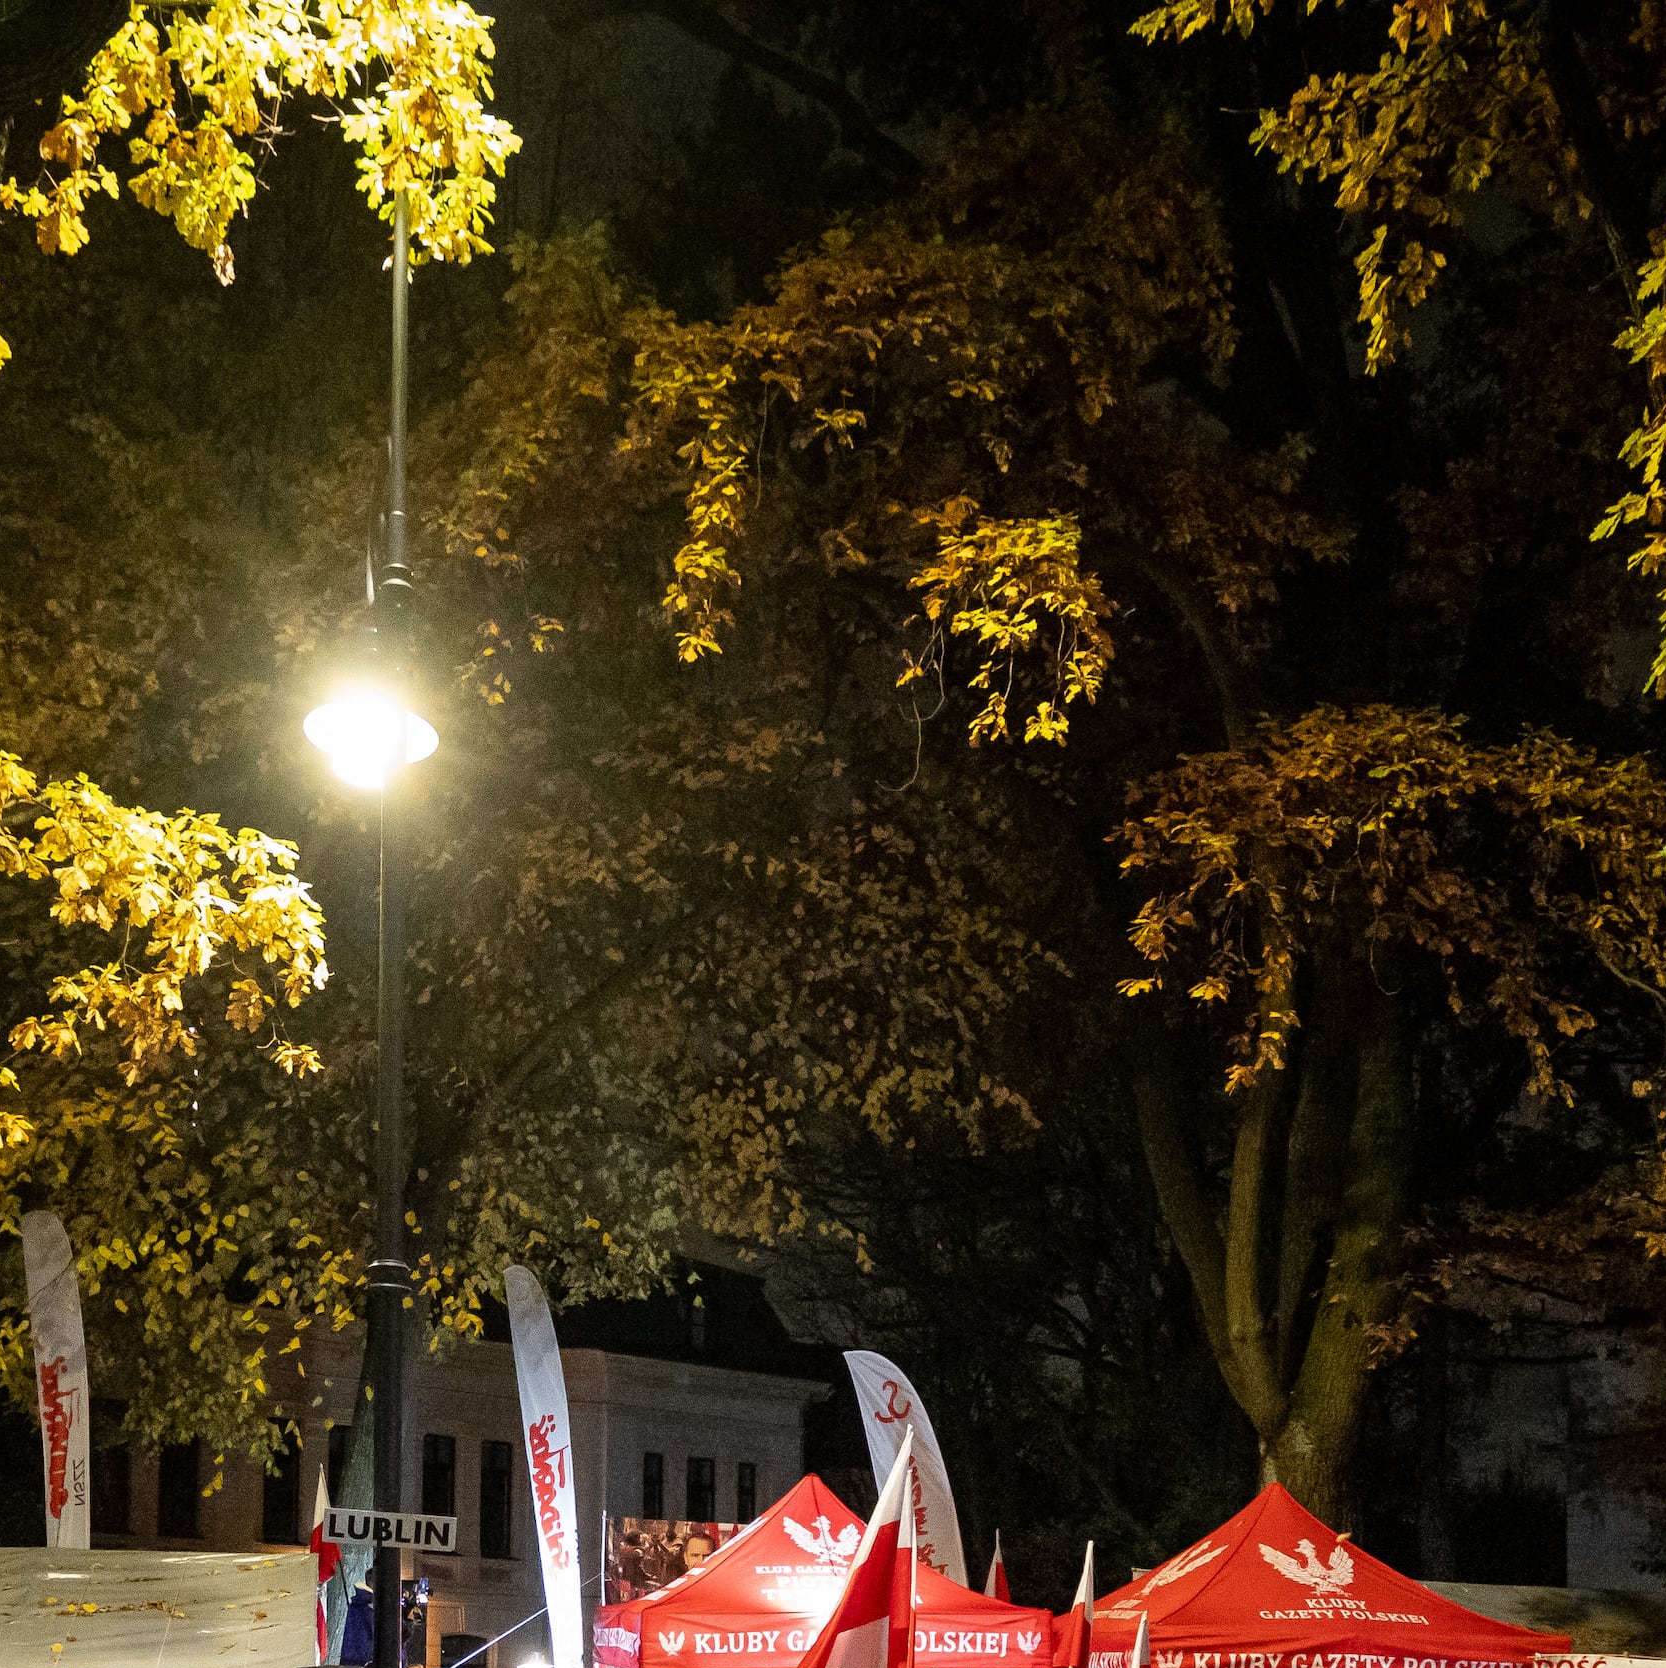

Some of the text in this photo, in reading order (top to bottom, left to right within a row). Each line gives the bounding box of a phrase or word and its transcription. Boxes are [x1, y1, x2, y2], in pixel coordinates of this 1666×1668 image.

[327, 1511, 451, 1548] LUBLIN
[1305, 1598, 1366, 1611] KLUBY
[1259, 1609, 1430, 1625] GAZETY POLSKIEJ
[694, 1631, 783, 1654] KLUBY
[914, 1631, 1010, 1657] OLSKIEJ
